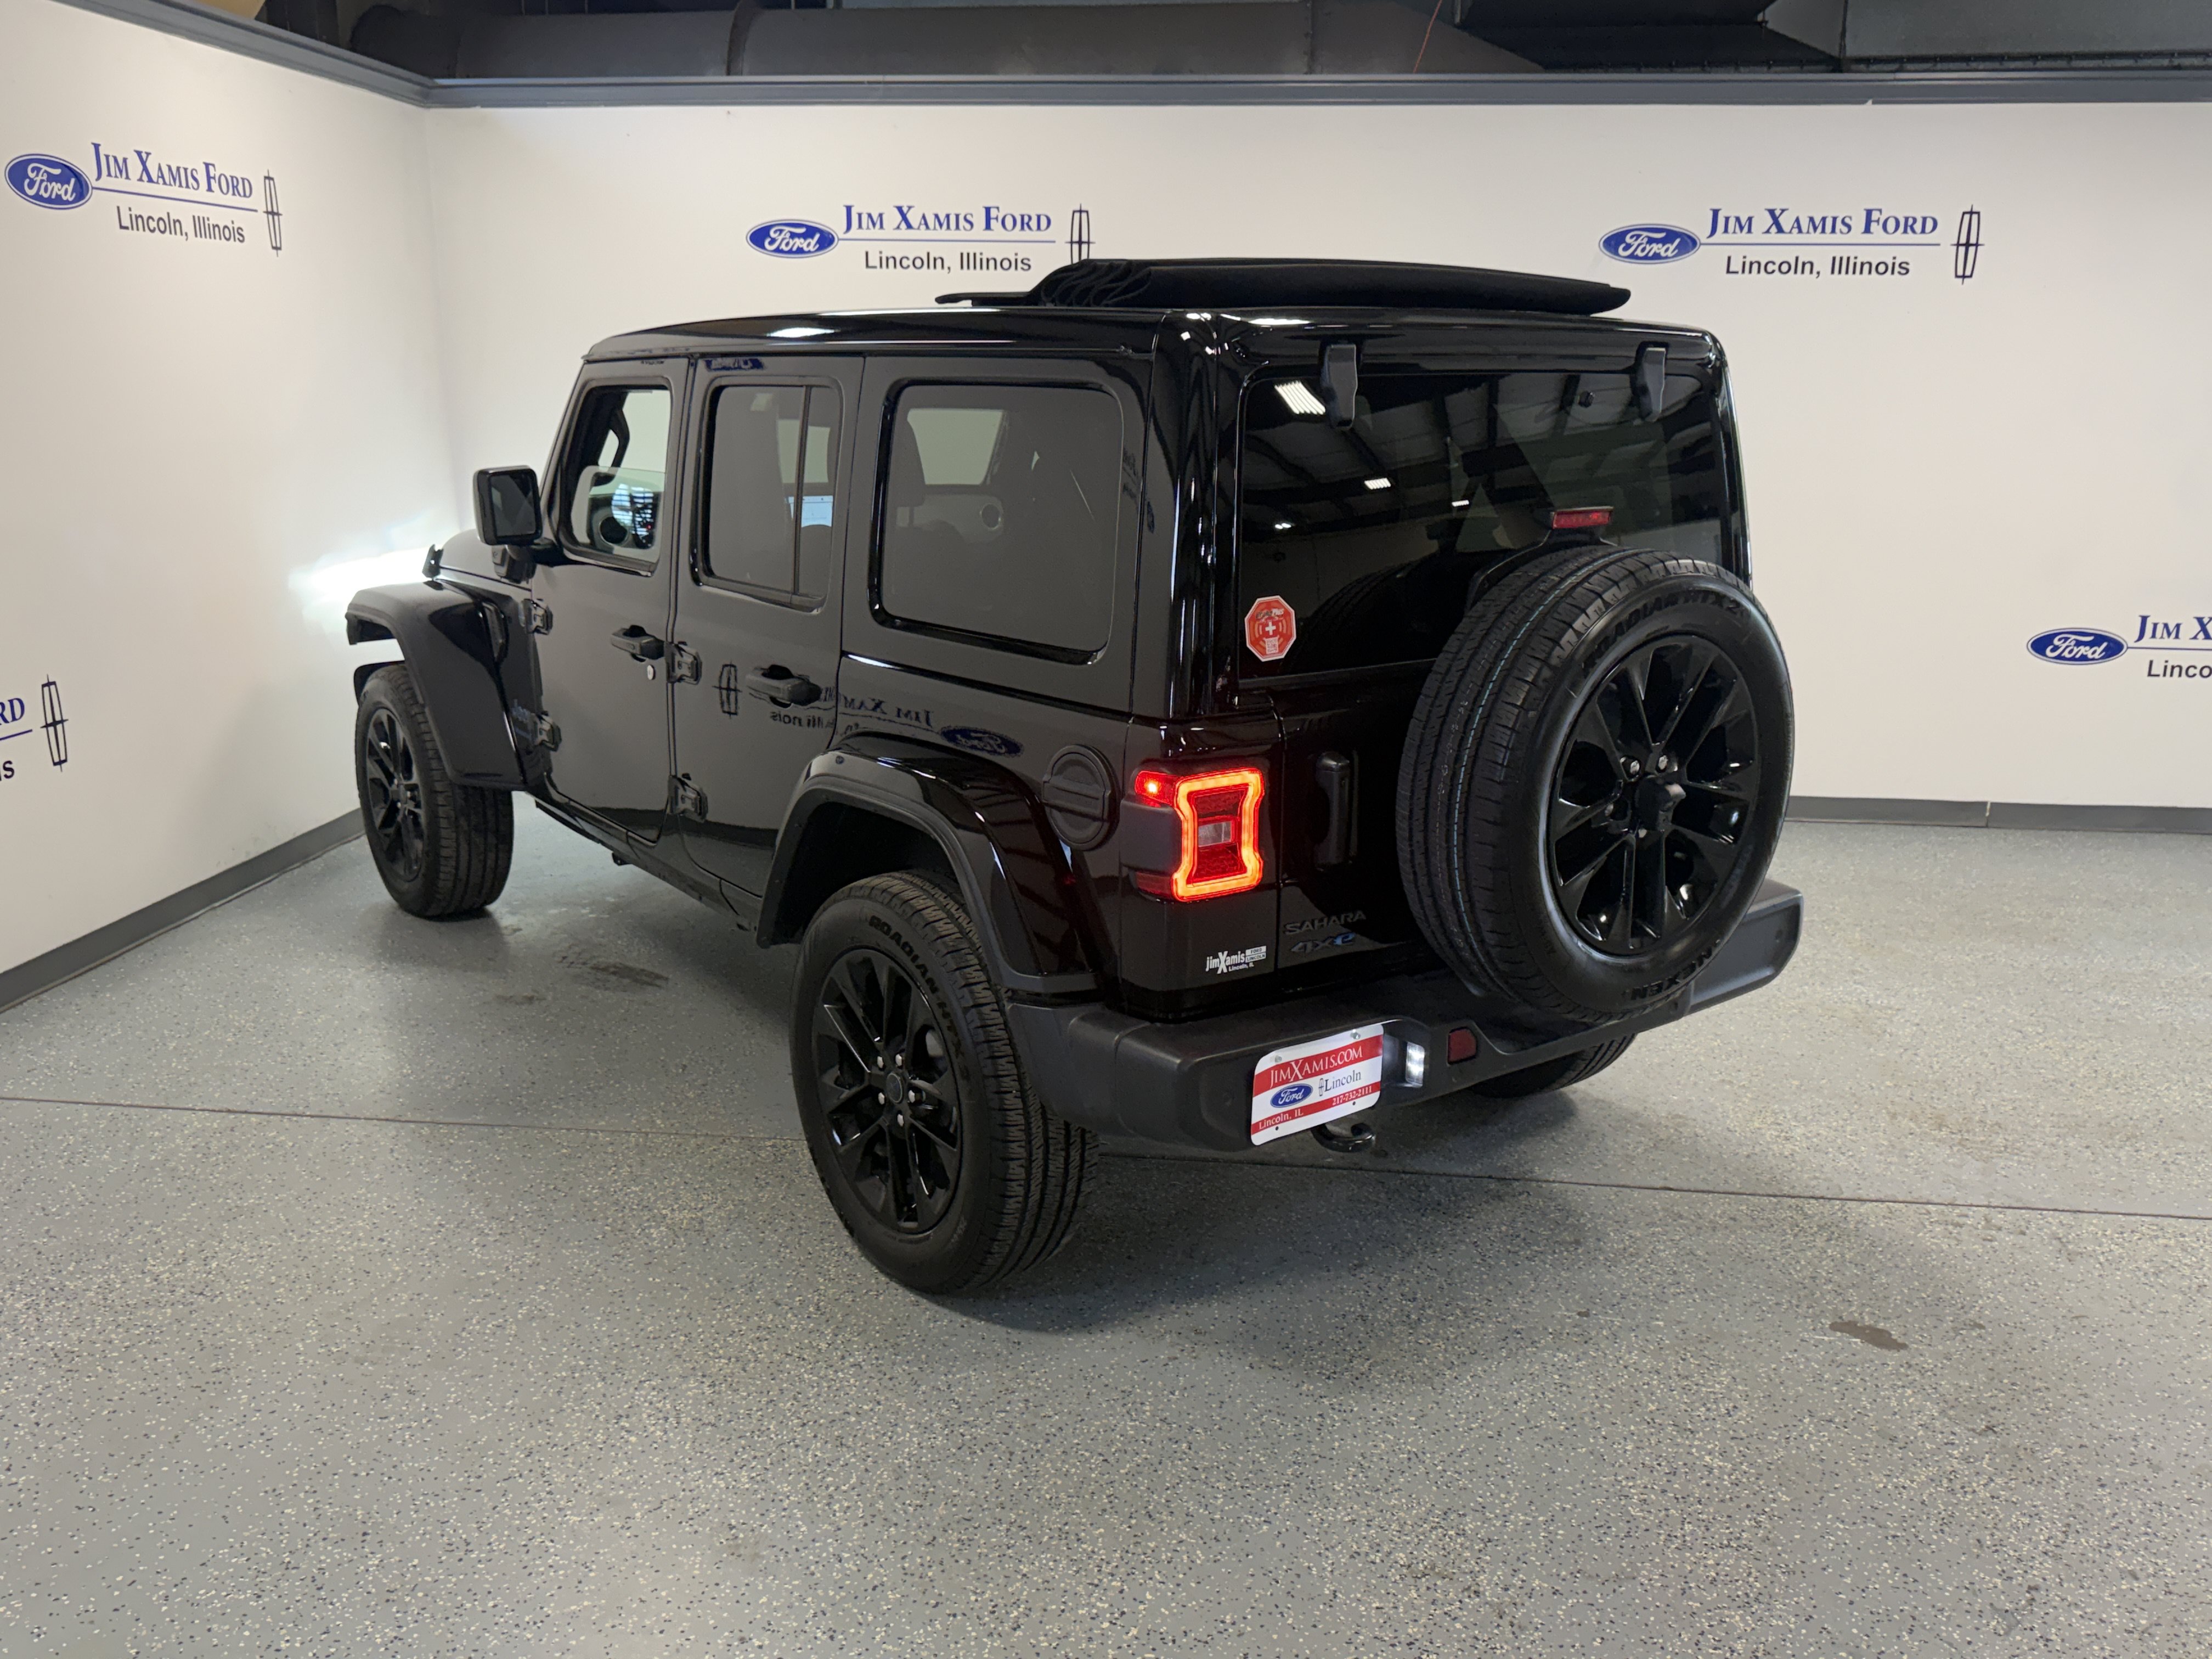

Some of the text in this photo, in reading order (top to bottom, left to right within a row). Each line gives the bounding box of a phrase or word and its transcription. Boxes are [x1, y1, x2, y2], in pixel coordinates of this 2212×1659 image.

[24, 162, 76, 201] Ford
[91, 142, 253, 199] JIM XAMIS FORD
[116, 205, 245, 243] Lincoln, Illinois
[842, 205, 1052, 235] JIM XAMIS FORD
[1706, 208, 1938, 239] JIM XAMIS FORD
[764, 225, 820, 252] Ford
[1617, 230, 1682, 258] Ford
[865, 251, 1031, 273] Lincoln, Illinois
[1725, 255, 1910, 279] Lincoln, Illinois
[2134, 615, 2183, 643] JIM
[2045, 633, 2108, 659] Ford
[1284, 911, 1367, 934] SAHARA
[1324, 1070, 1361, 1092] Lincoln
[1295, 1108, 1304, 1118] IL
